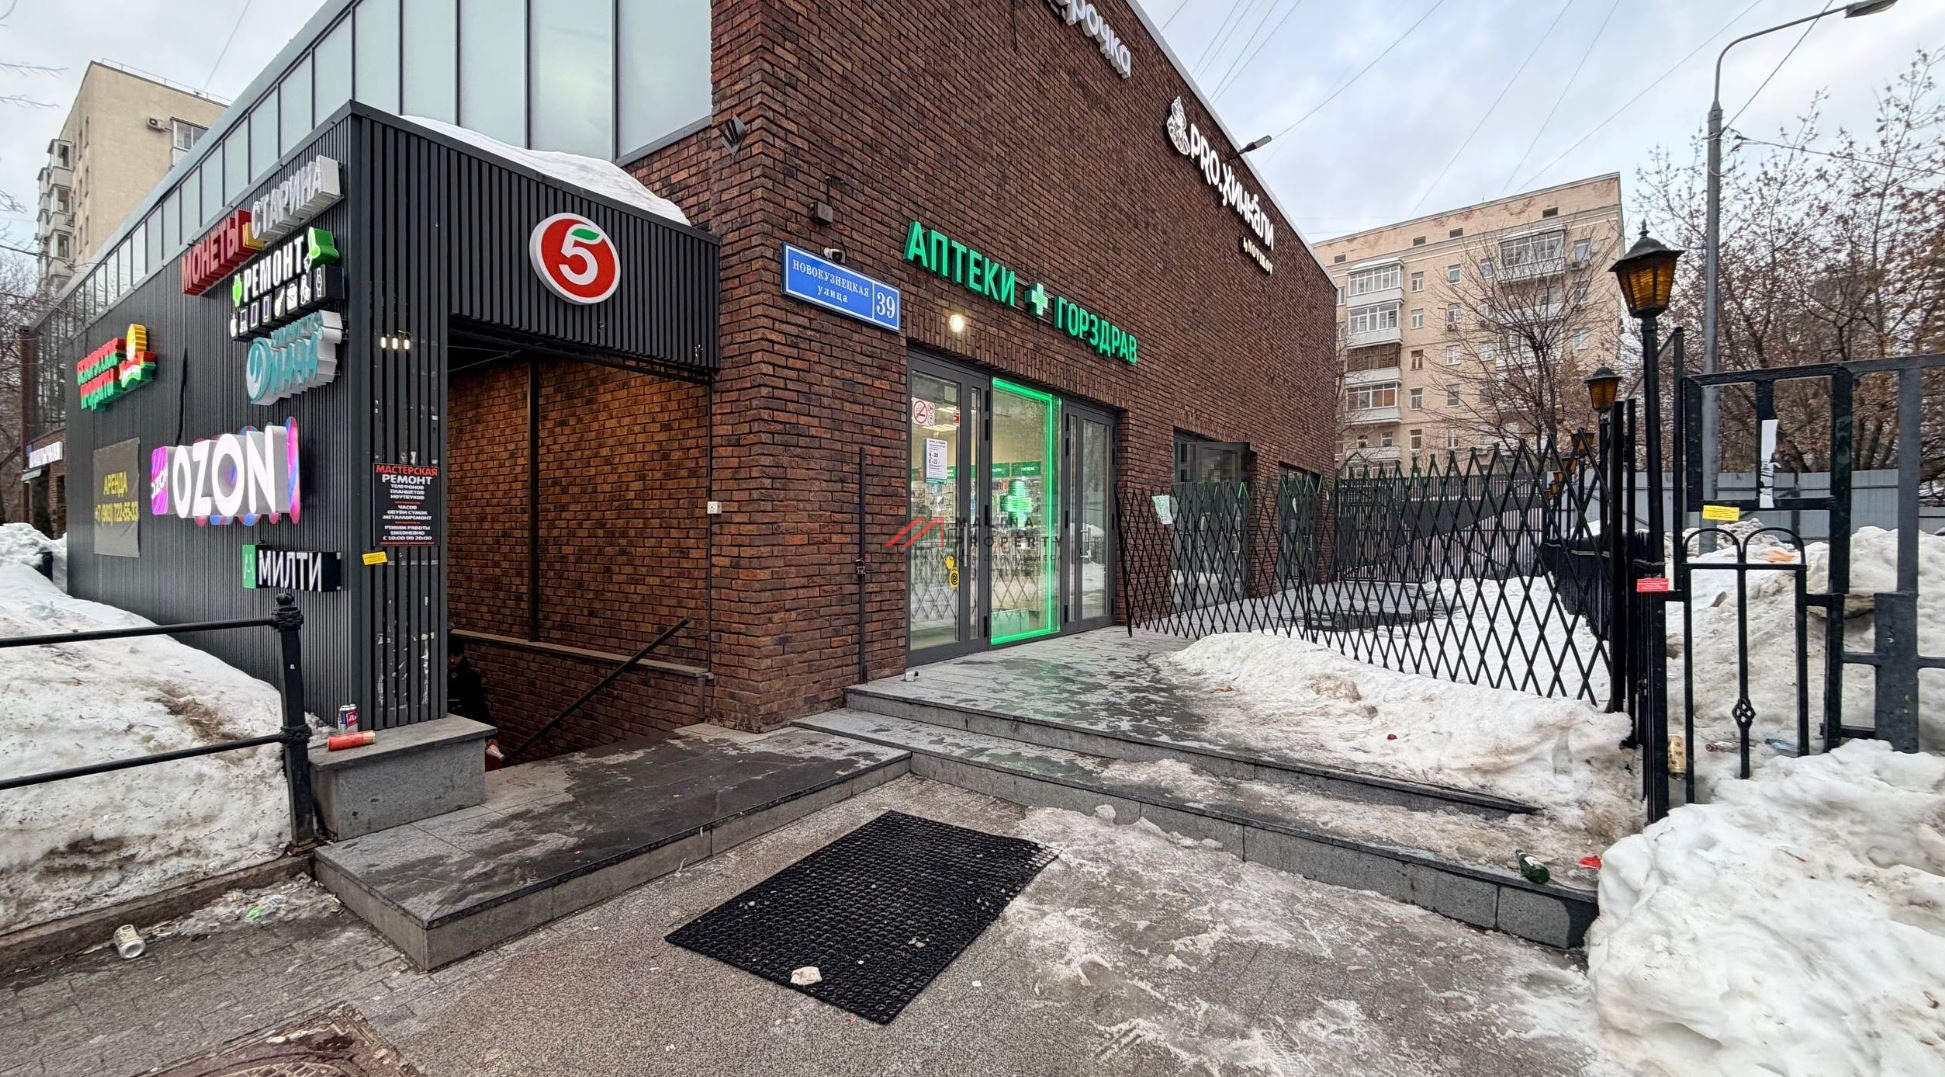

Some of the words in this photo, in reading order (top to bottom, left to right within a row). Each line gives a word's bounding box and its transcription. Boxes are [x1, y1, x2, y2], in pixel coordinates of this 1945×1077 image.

[181, 209, 240, 295] МОНЕТЫ
[251, 154, 322, 240] СТАРИНА
[244, 236, 304, 303] РЕМОНТ
[558, 224, 600, 286] 5
[793, 259, 869, 297] НОВОКУЗНЕЦКАЯ
[817, 285, 848, 303] улица
[903, 220, 1016, 308] АПТЕКИ
[1054, 296, 1138, 364] ГОРЗДРАВ
[876, 292, 896, 319] 39
[103, 471, 128, 498] АРЕНДА
[173, 425, 277, 519] OZON
[376, 465, 438, 476] МАСТЕРСКАЯ
[382, 474, 432, 485] РЕМОНТ
[258, 549, 322, 592] МИЛТИ
